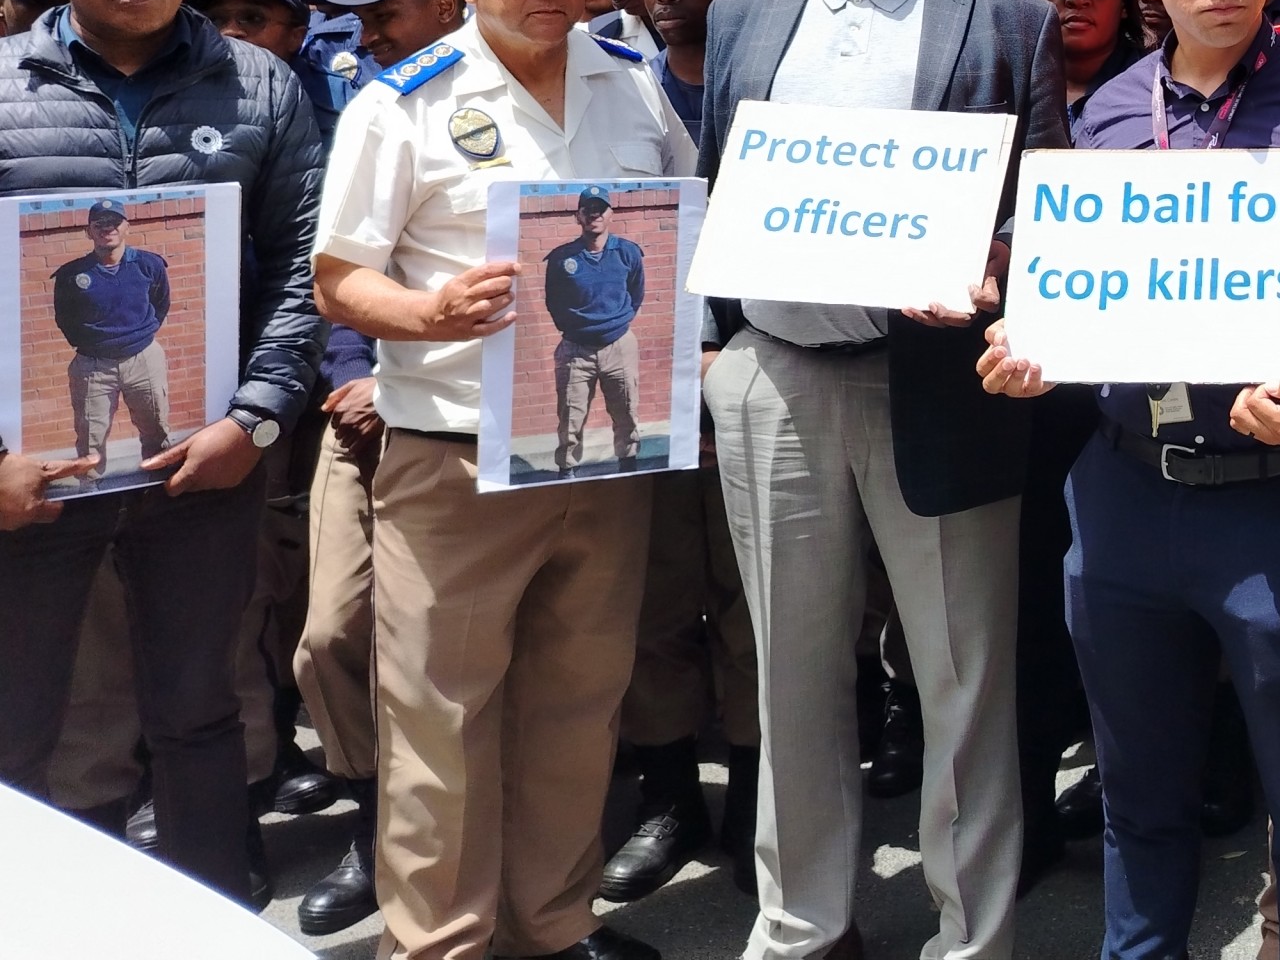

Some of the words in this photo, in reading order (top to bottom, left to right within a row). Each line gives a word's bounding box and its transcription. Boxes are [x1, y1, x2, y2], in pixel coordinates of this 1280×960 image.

[738, 128, 898, 168] Protect
[911, 142, 988, 172] our
[762, 197, 929, 239] officers
[1032, 183, 1105, 223] No
[1121, 180, 1212, 224] bail
